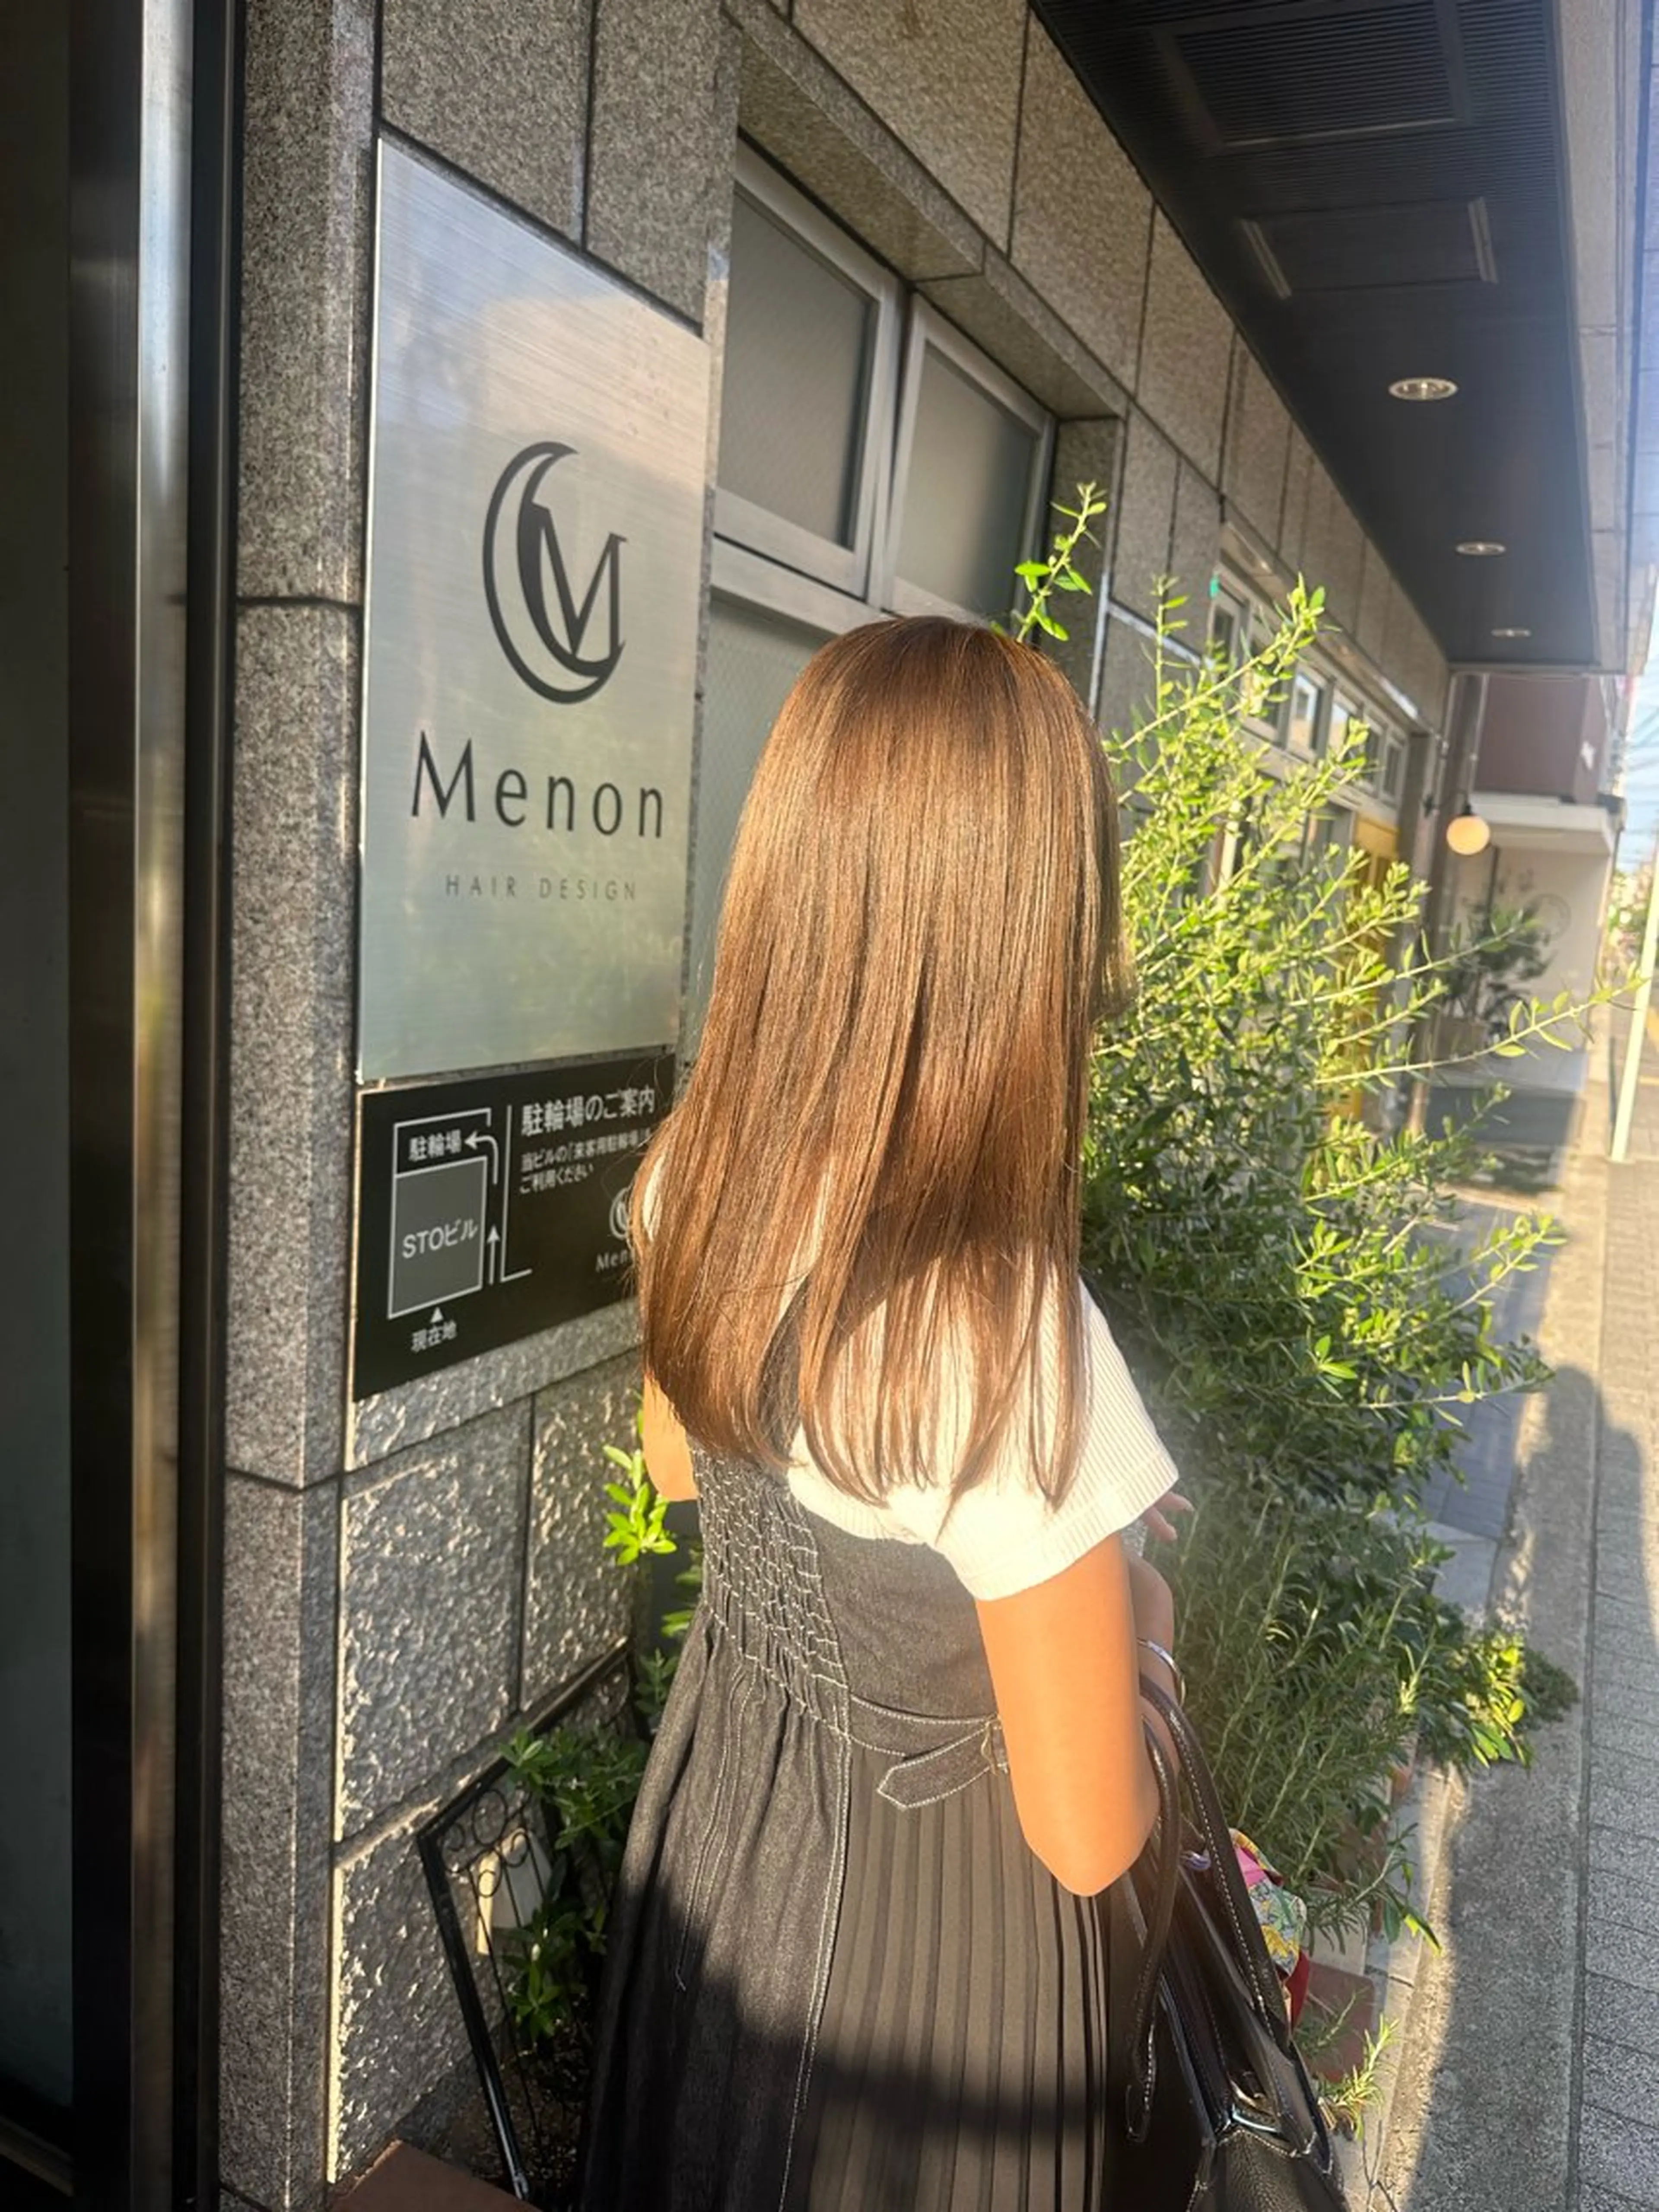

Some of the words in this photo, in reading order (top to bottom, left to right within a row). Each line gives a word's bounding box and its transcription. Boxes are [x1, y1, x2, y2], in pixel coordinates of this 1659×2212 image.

[411, 730, 663, 839] Menon
[446, 874, 515, 897] HAIR
[540, 877, 637, 901] DESIGN
[521, 1085, 655, 1137] 駐輪場のご案内
[409, 1129, 461, 1162] 駐輪場
[520, 1163, 594, 1194] ご利用ください
[402, 1218, 478, 1259] STOビル
[595, 1249, 628, 1273] Men
[411, 1319, 457, 1354] 現在地
